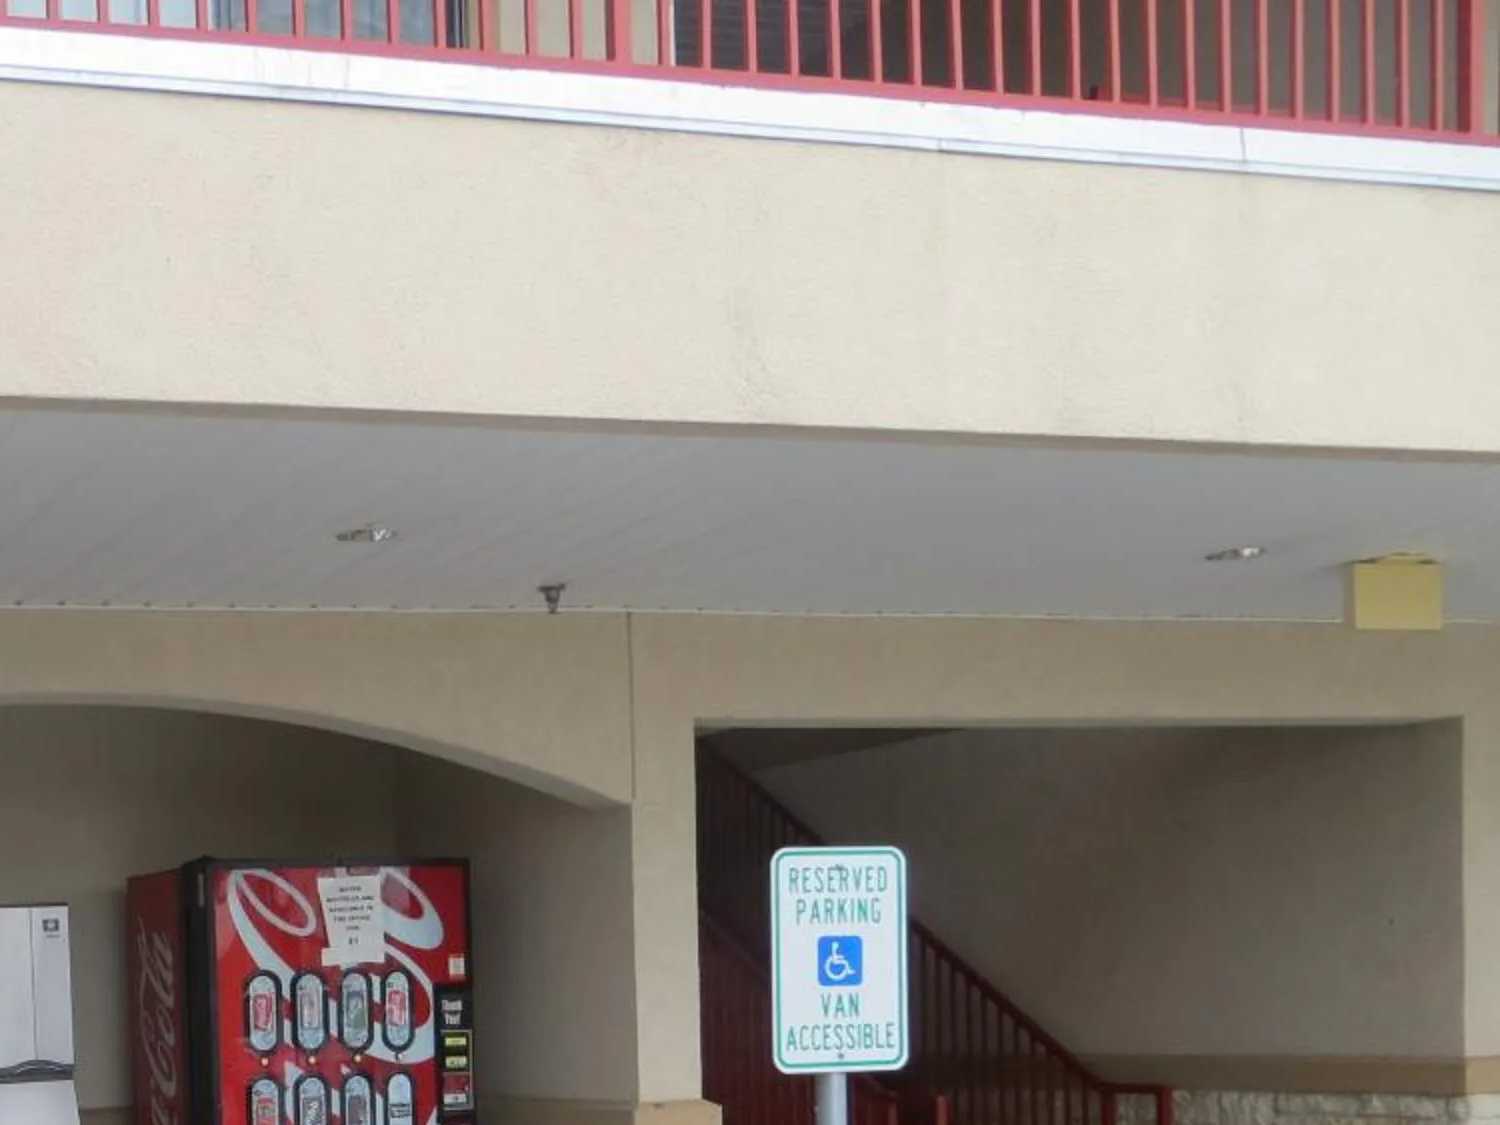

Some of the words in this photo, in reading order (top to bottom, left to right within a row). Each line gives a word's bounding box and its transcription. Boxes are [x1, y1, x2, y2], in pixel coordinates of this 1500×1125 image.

[788, 866, 888, 893] RESERVED
[796, 898, 881, 924] PARKING
[820, 993, 860, 1018] VAN
[786, 1022, 896, 1051] ACCESSIBLE
